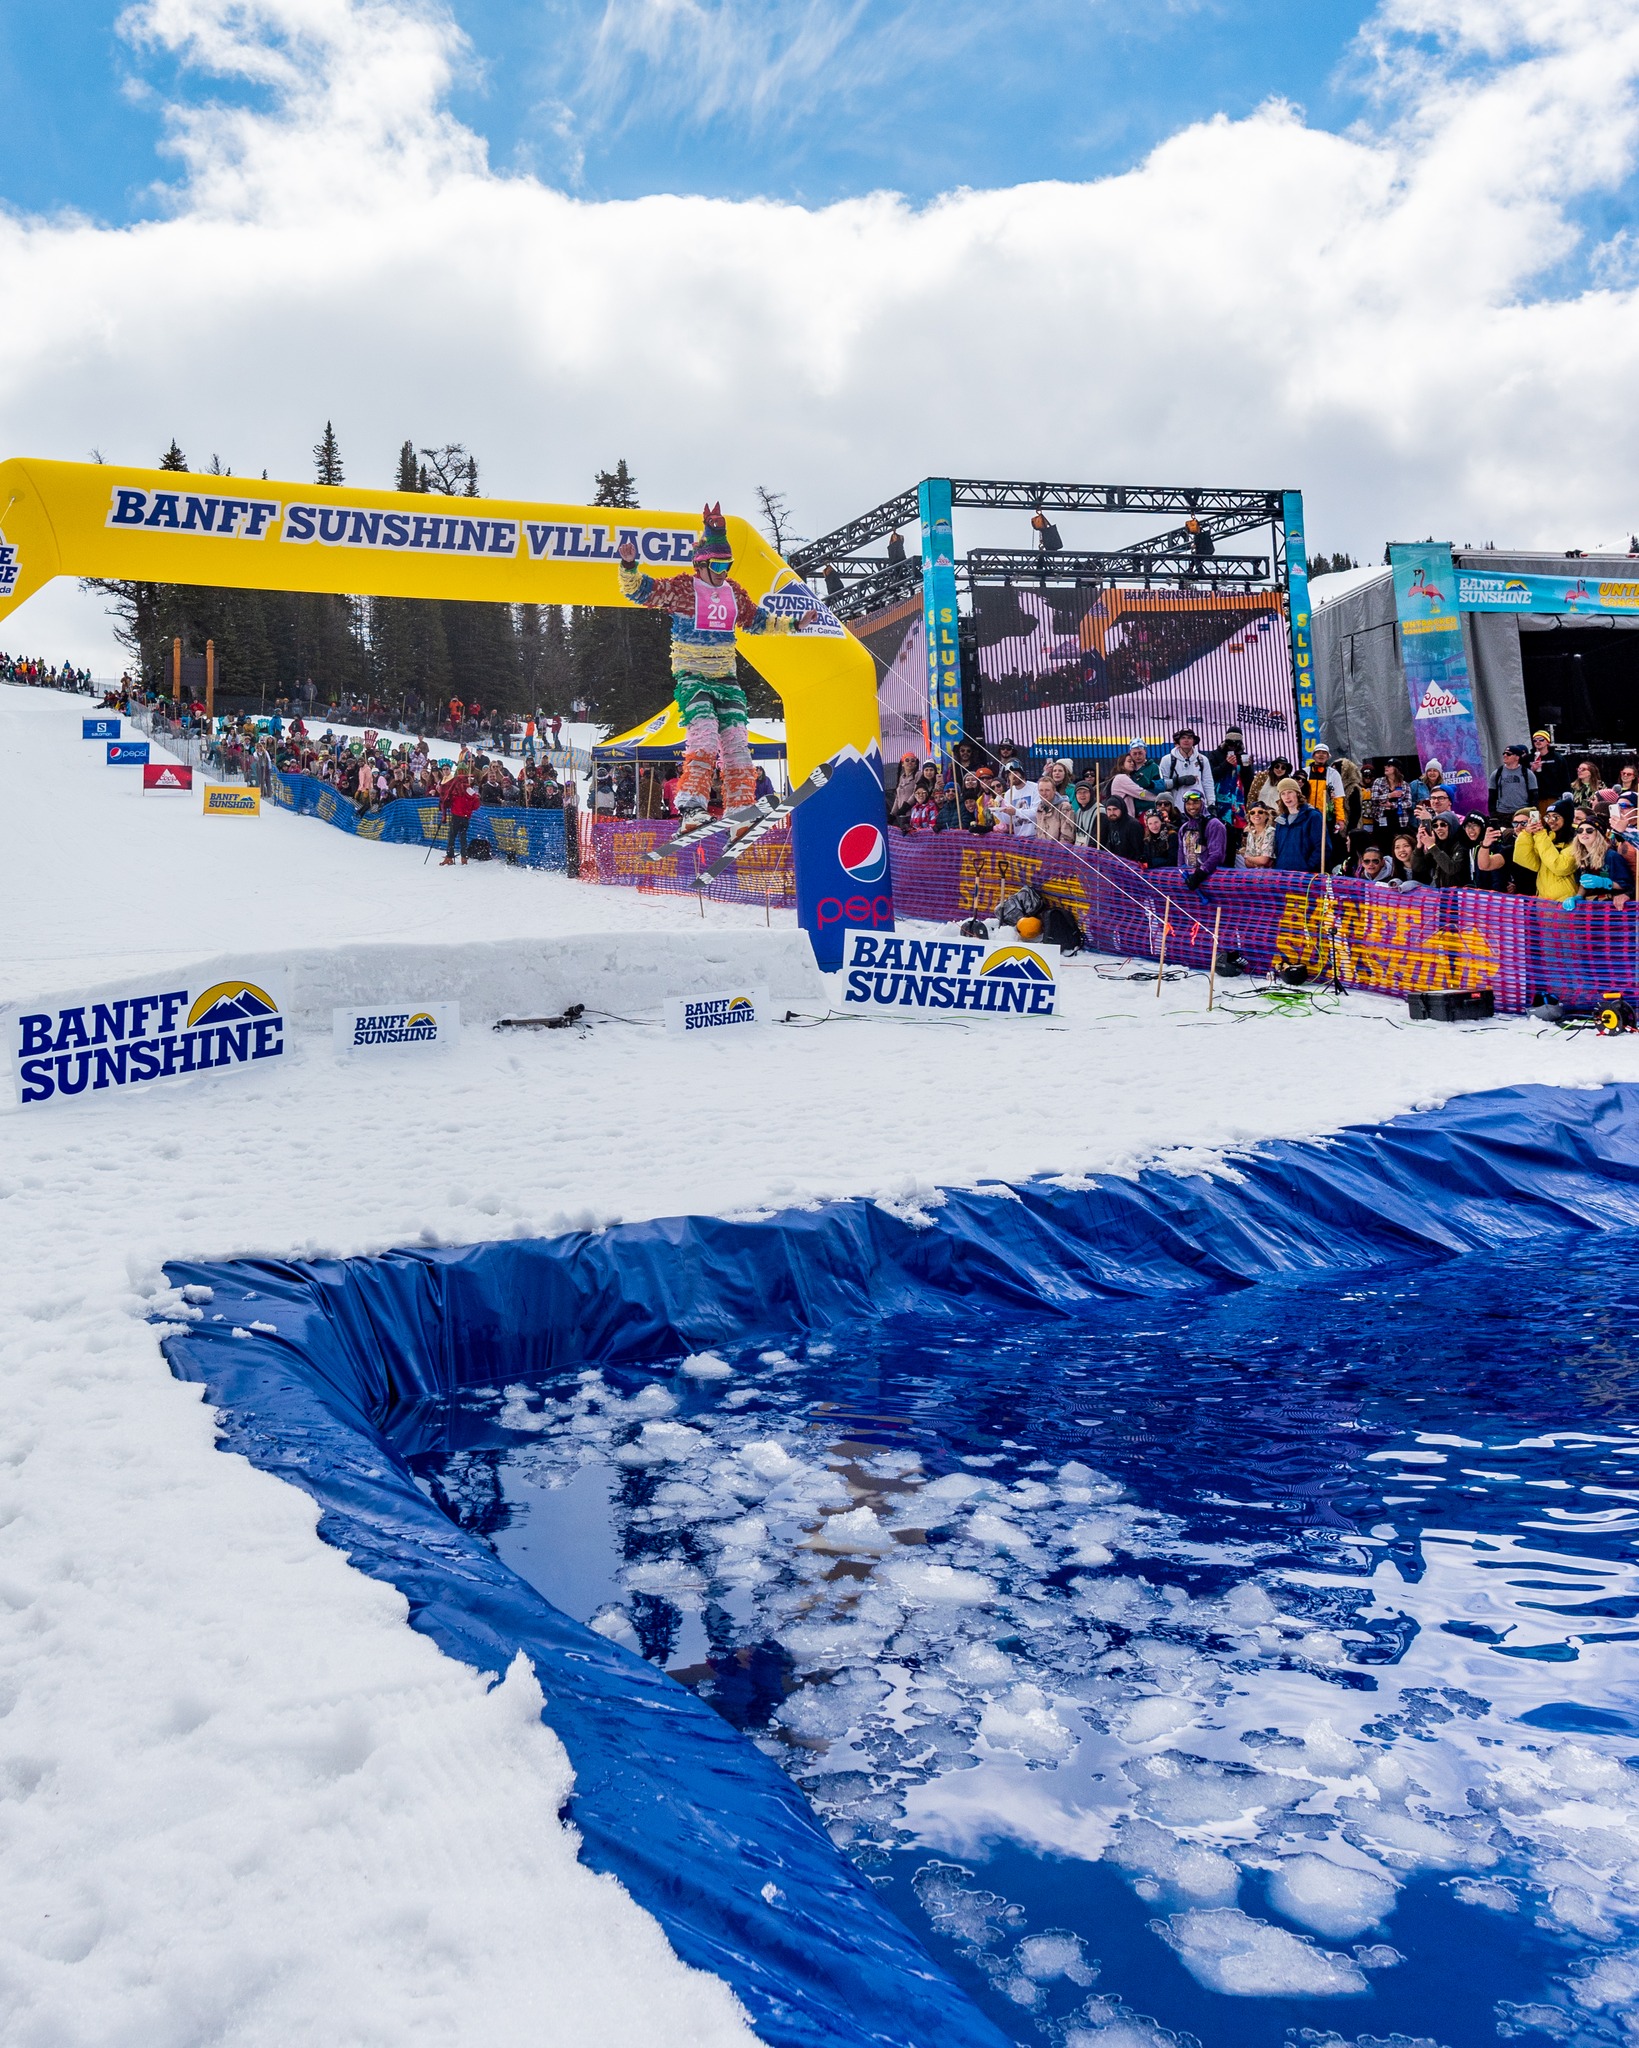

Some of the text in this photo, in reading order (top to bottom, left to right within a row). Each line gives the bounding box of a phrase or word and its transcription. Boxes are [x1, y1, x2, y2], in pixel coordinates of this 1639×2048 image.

[111, 490, 695, 563] BANFF SUNSHINE VILLAGE
[1459, 578, 1505, 591] BANFF
[1459, 591, 1532, 604] SUNSHINE
[708, 604, 728, 621] 20
[940, 607, 958, 708] SLUSH
[1297, 613, 1313, 707] SLUSH
[1421, 692, 1458, 708] Coors
[1428, 705, 1452, 716] LIGHT
[122, 749, 147, 758] pepsi
[209, 800, 256, 809] SUNSHINE
[210, 793, 240, 801] BANFF
[1278, 893, 1422, 946] BANFF
[850, 936, 985, 975] BANFF
[845, 970, 1056, 1015] SUNSHINE
[685, 999, 730, 1017] BANFF
[18, 990, 188, 1058] BANFF
[354, 1014, 409, 1031] BANFF
[685, 1009, 754, 1030] SUNSHINE
[353, 1026, 437, 1046] SUNSHINE
[20, 1017, 284, 1103] SUNSHINE
